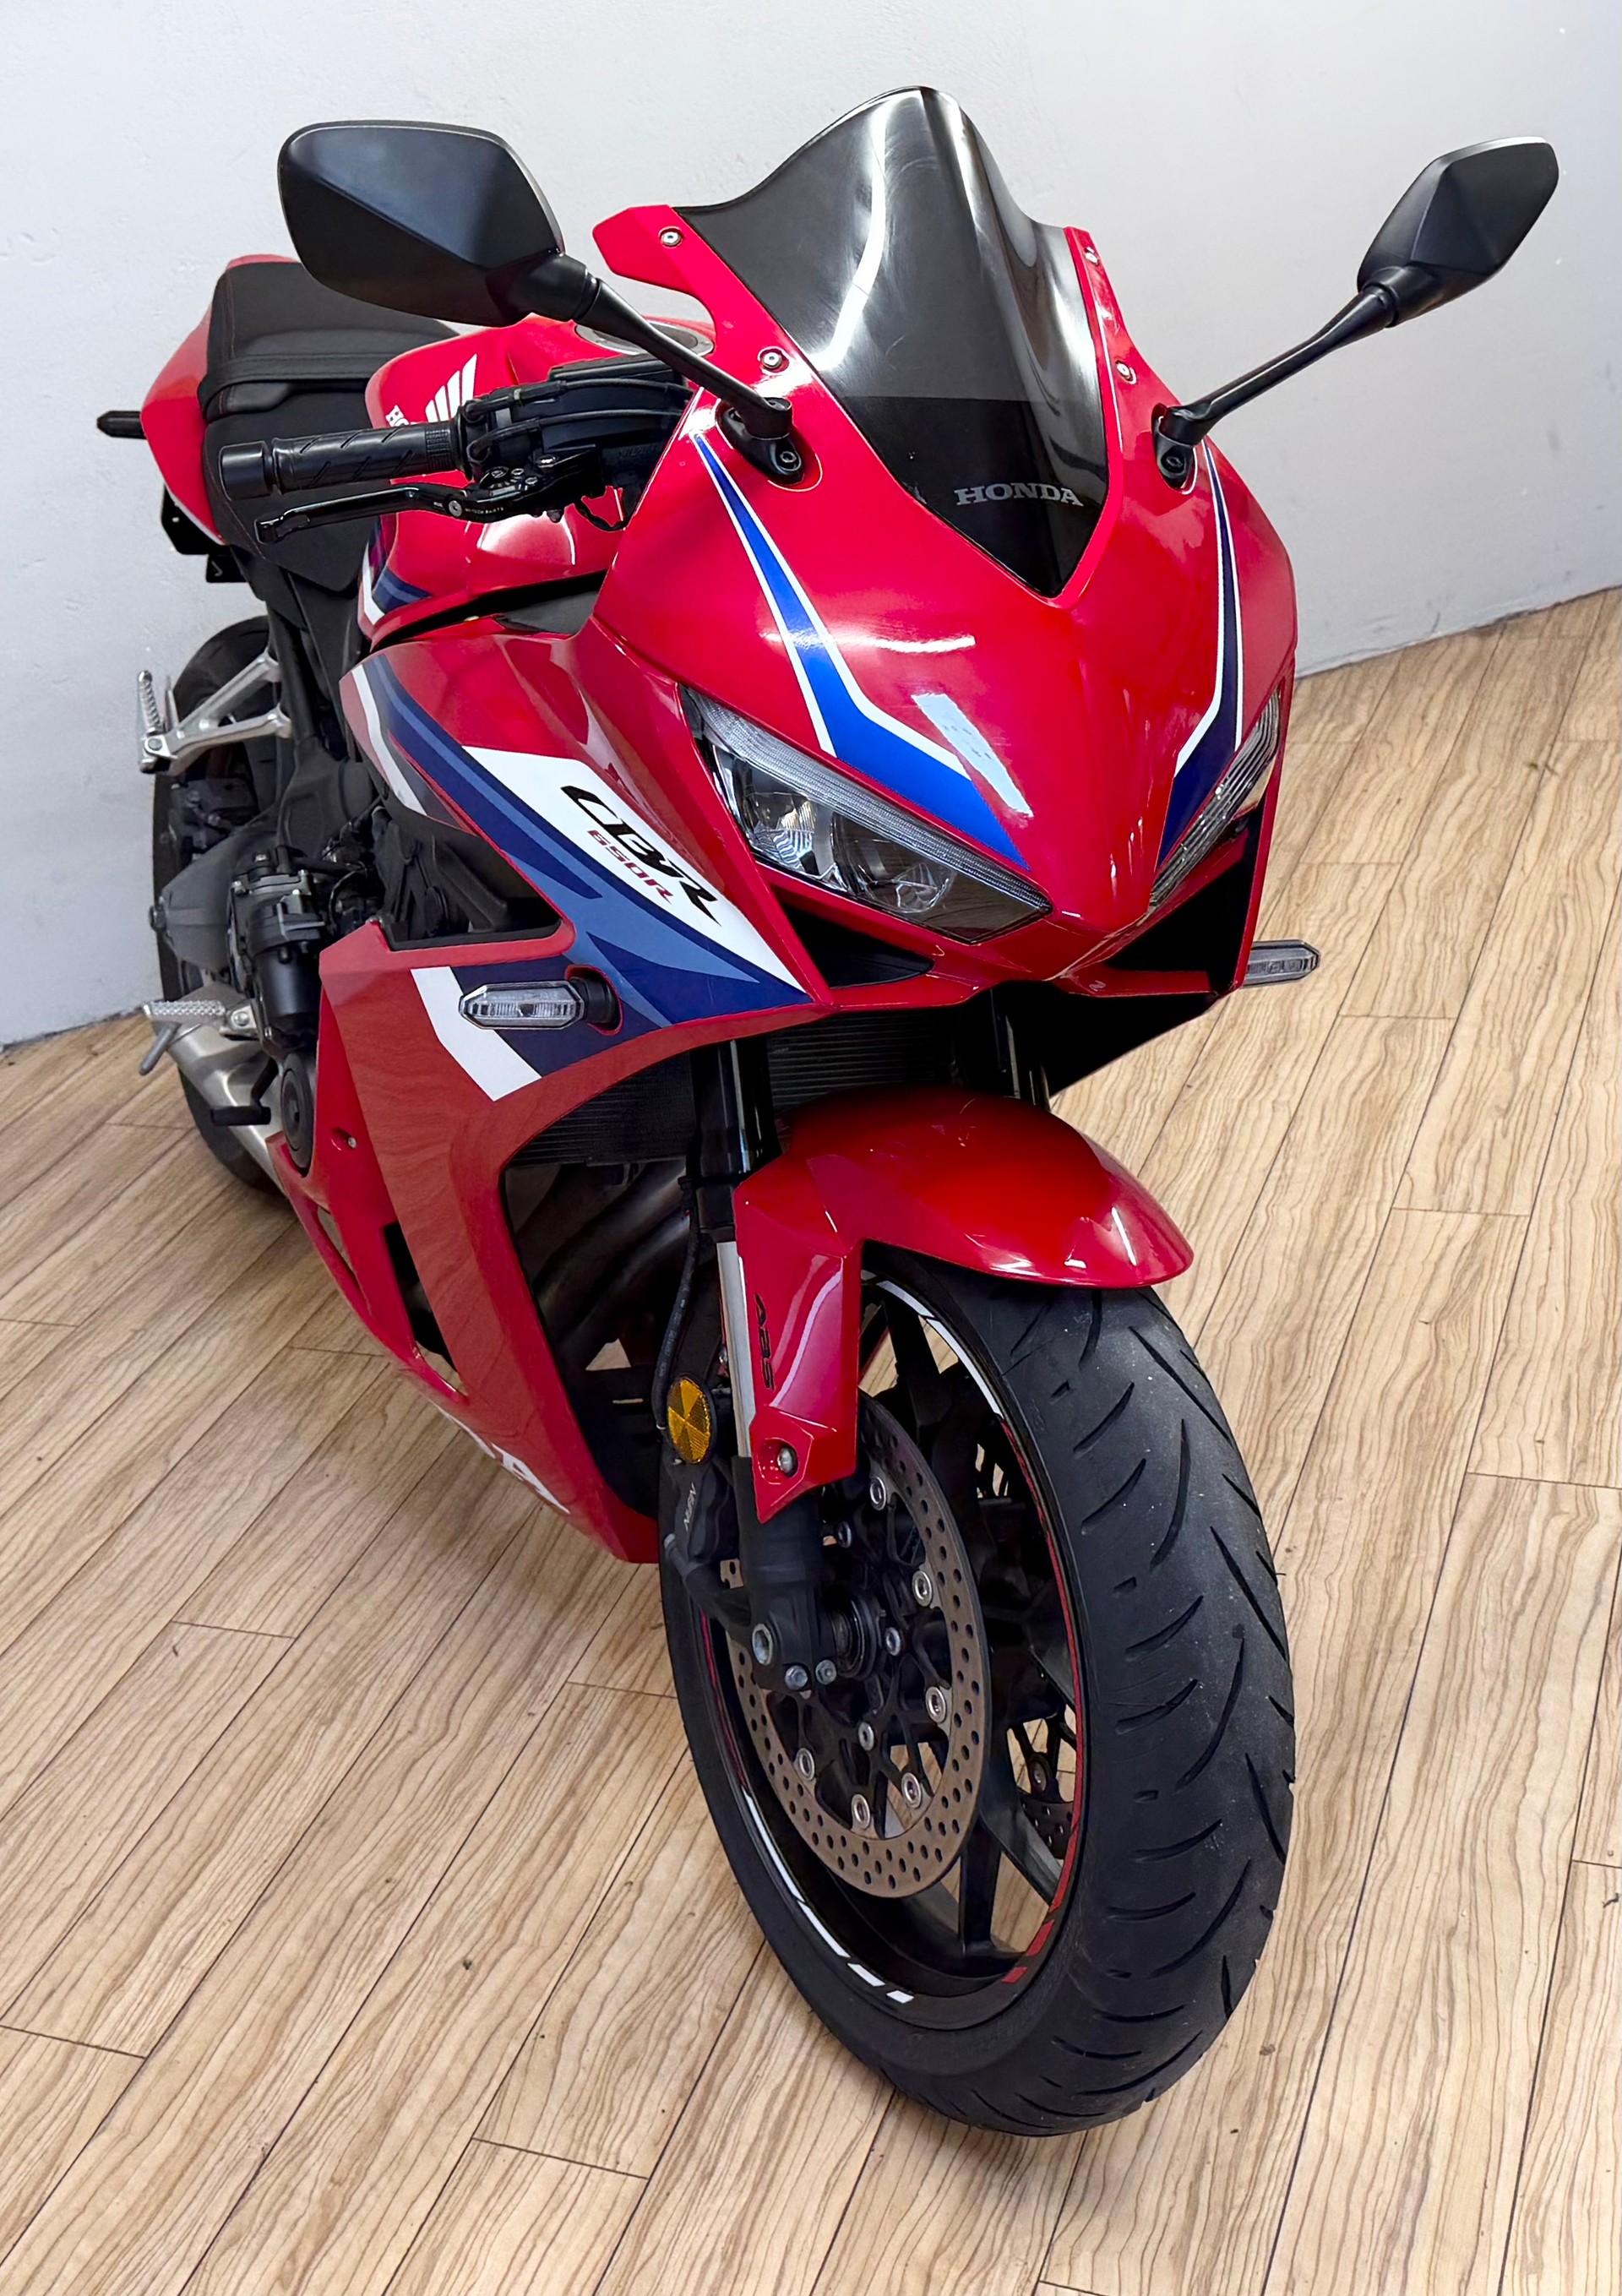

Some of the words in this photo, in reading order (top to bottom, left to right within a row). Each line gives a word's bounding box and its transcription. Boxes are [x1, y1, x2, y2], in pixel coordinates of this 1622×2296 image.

[954, 482, 1084, 507] HONDA
[560, 785, 722, 927] CBR
[587, 830, 674, 905] 650R
[754, 1292, 776, 1392] ABS
